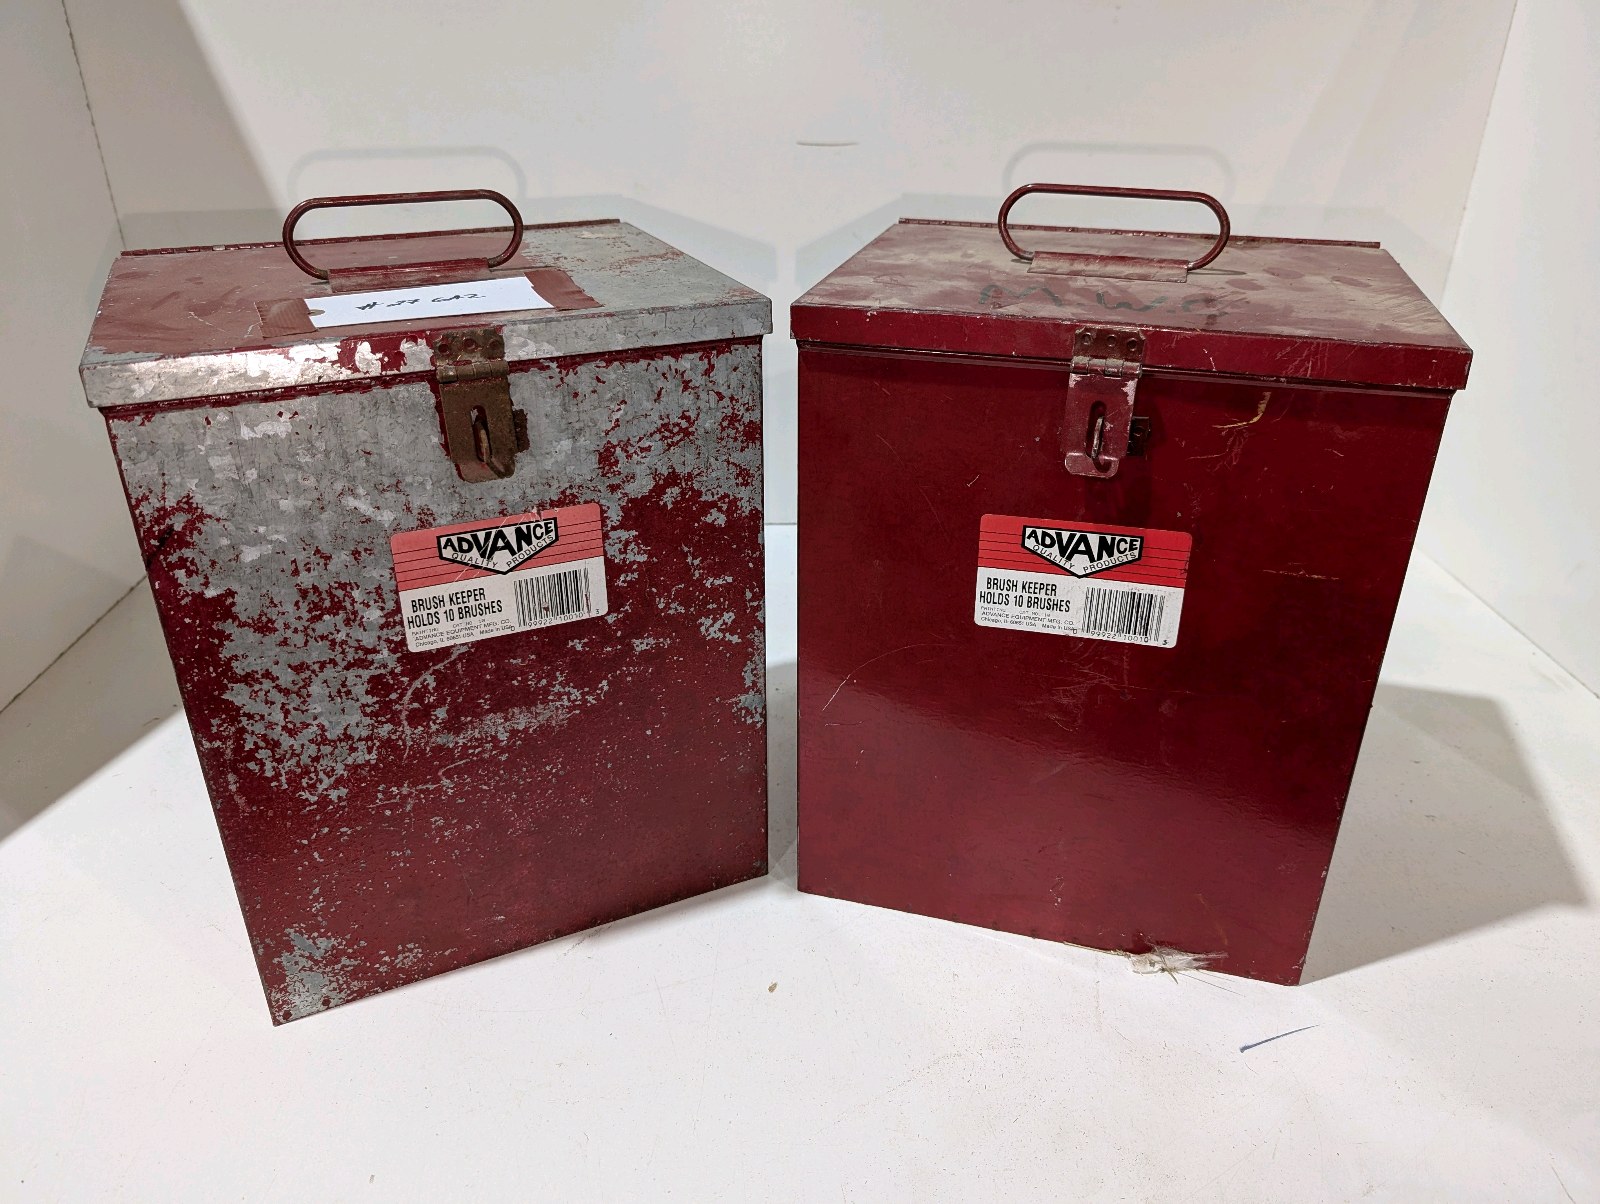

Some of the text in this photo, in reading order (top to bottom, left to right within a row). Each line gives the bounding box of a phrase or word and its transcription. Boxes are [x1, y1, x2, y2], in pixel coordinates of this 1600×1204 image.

[443, 521, 553, 559] ADVANCE
[451, 535, 554, 569] QUALITY PRODUCTS
[1026, 529, 1139, 563] ADVANCE
[1032, 545, 1137, 573] QUALITY PRODUCTS
[986, 577, 1057, 596] BRUSH KEEPER
[411, 588, 486, 613] BRUSH KEEPER
[979, 591, 1071, 612] HOLDS 10 BRUSHES
[407, 600, 503, 629] HOLDS 10 BRUSHES
[528, 619, 553, 628] 99922
[415, 632, 445, 641] ADVANCE
[446, 624, 483, 636] EQUIPMENT
[484, 621, 499, 629] MFG.
[1090, 631, 1117, 640] 99922
